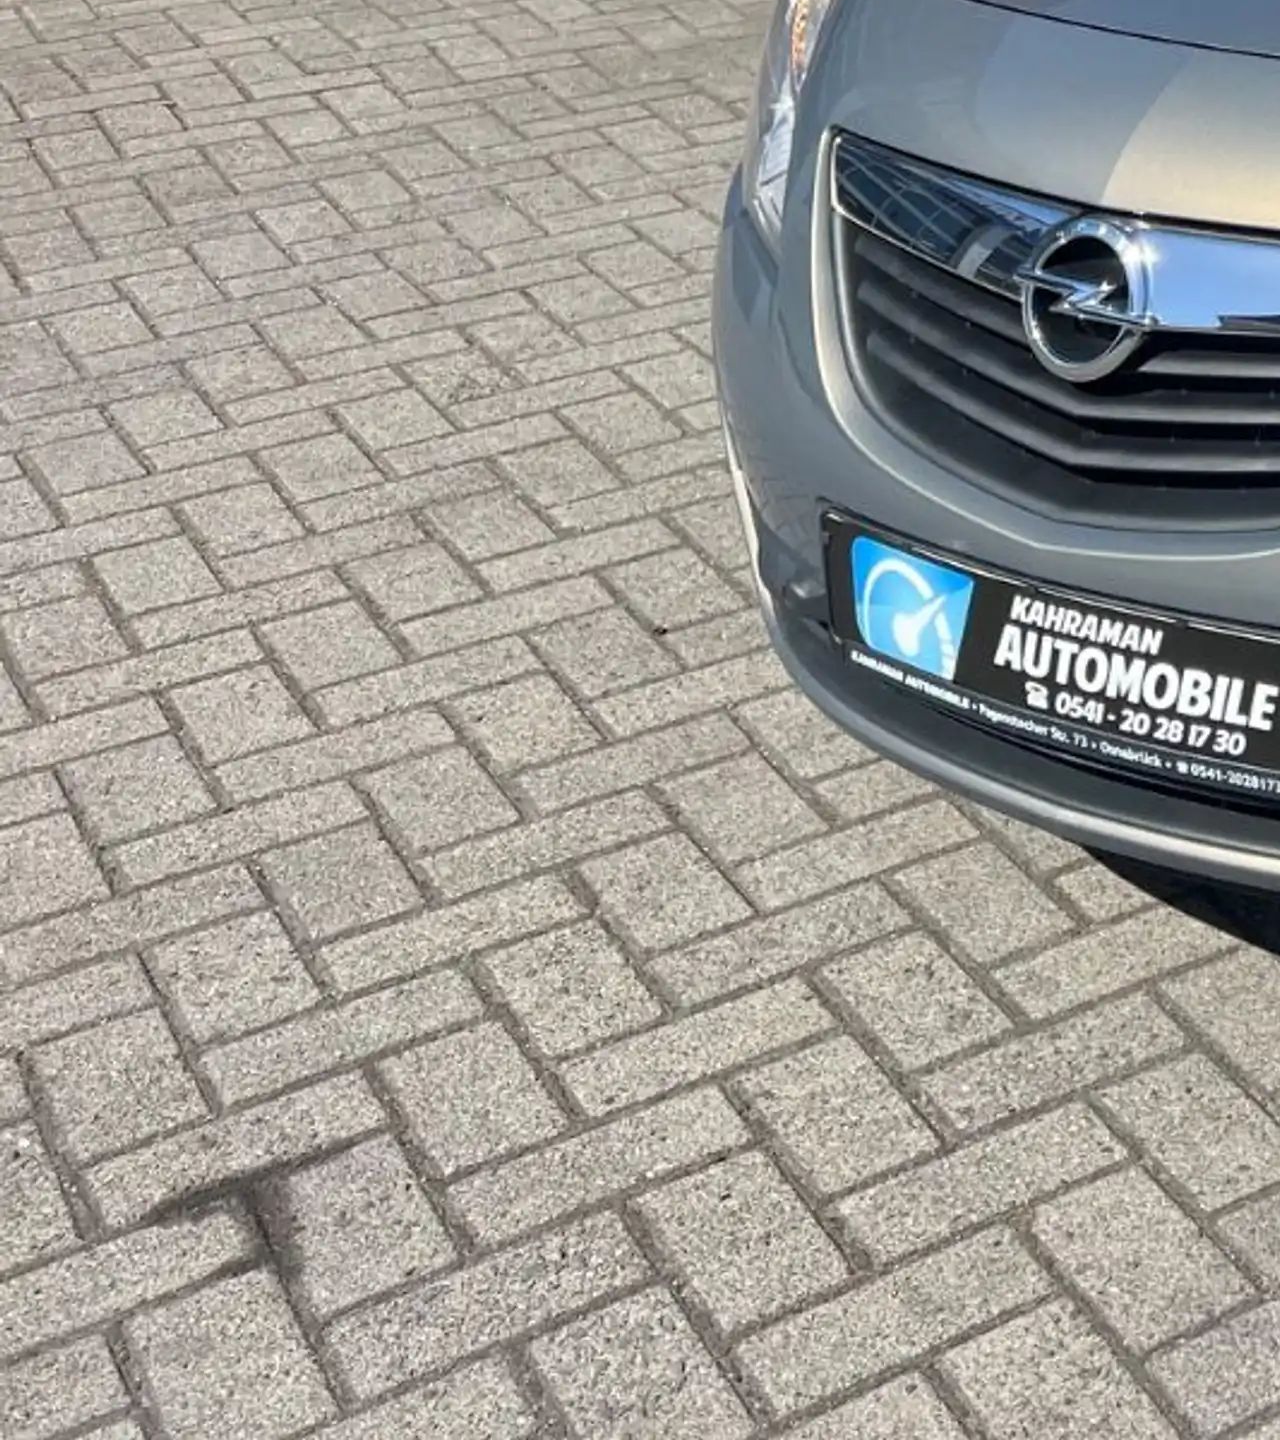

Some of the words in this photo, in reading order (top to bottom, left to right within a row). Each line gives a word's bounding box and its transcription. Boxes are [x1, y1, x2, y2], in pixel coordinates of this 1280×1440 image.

[1009, 595, 1164, 656] KAHRAMAN
[993, 624, 1280, 731] AUTOMOBILE
[1055, 692, 1105, 725] 0541
[1119, 710, 1150, 736] 20
[1152, 717, 1184, 743] 28
[1187, 725, 1211, 748] 17
[1212, 731, 1247, 756] 30
